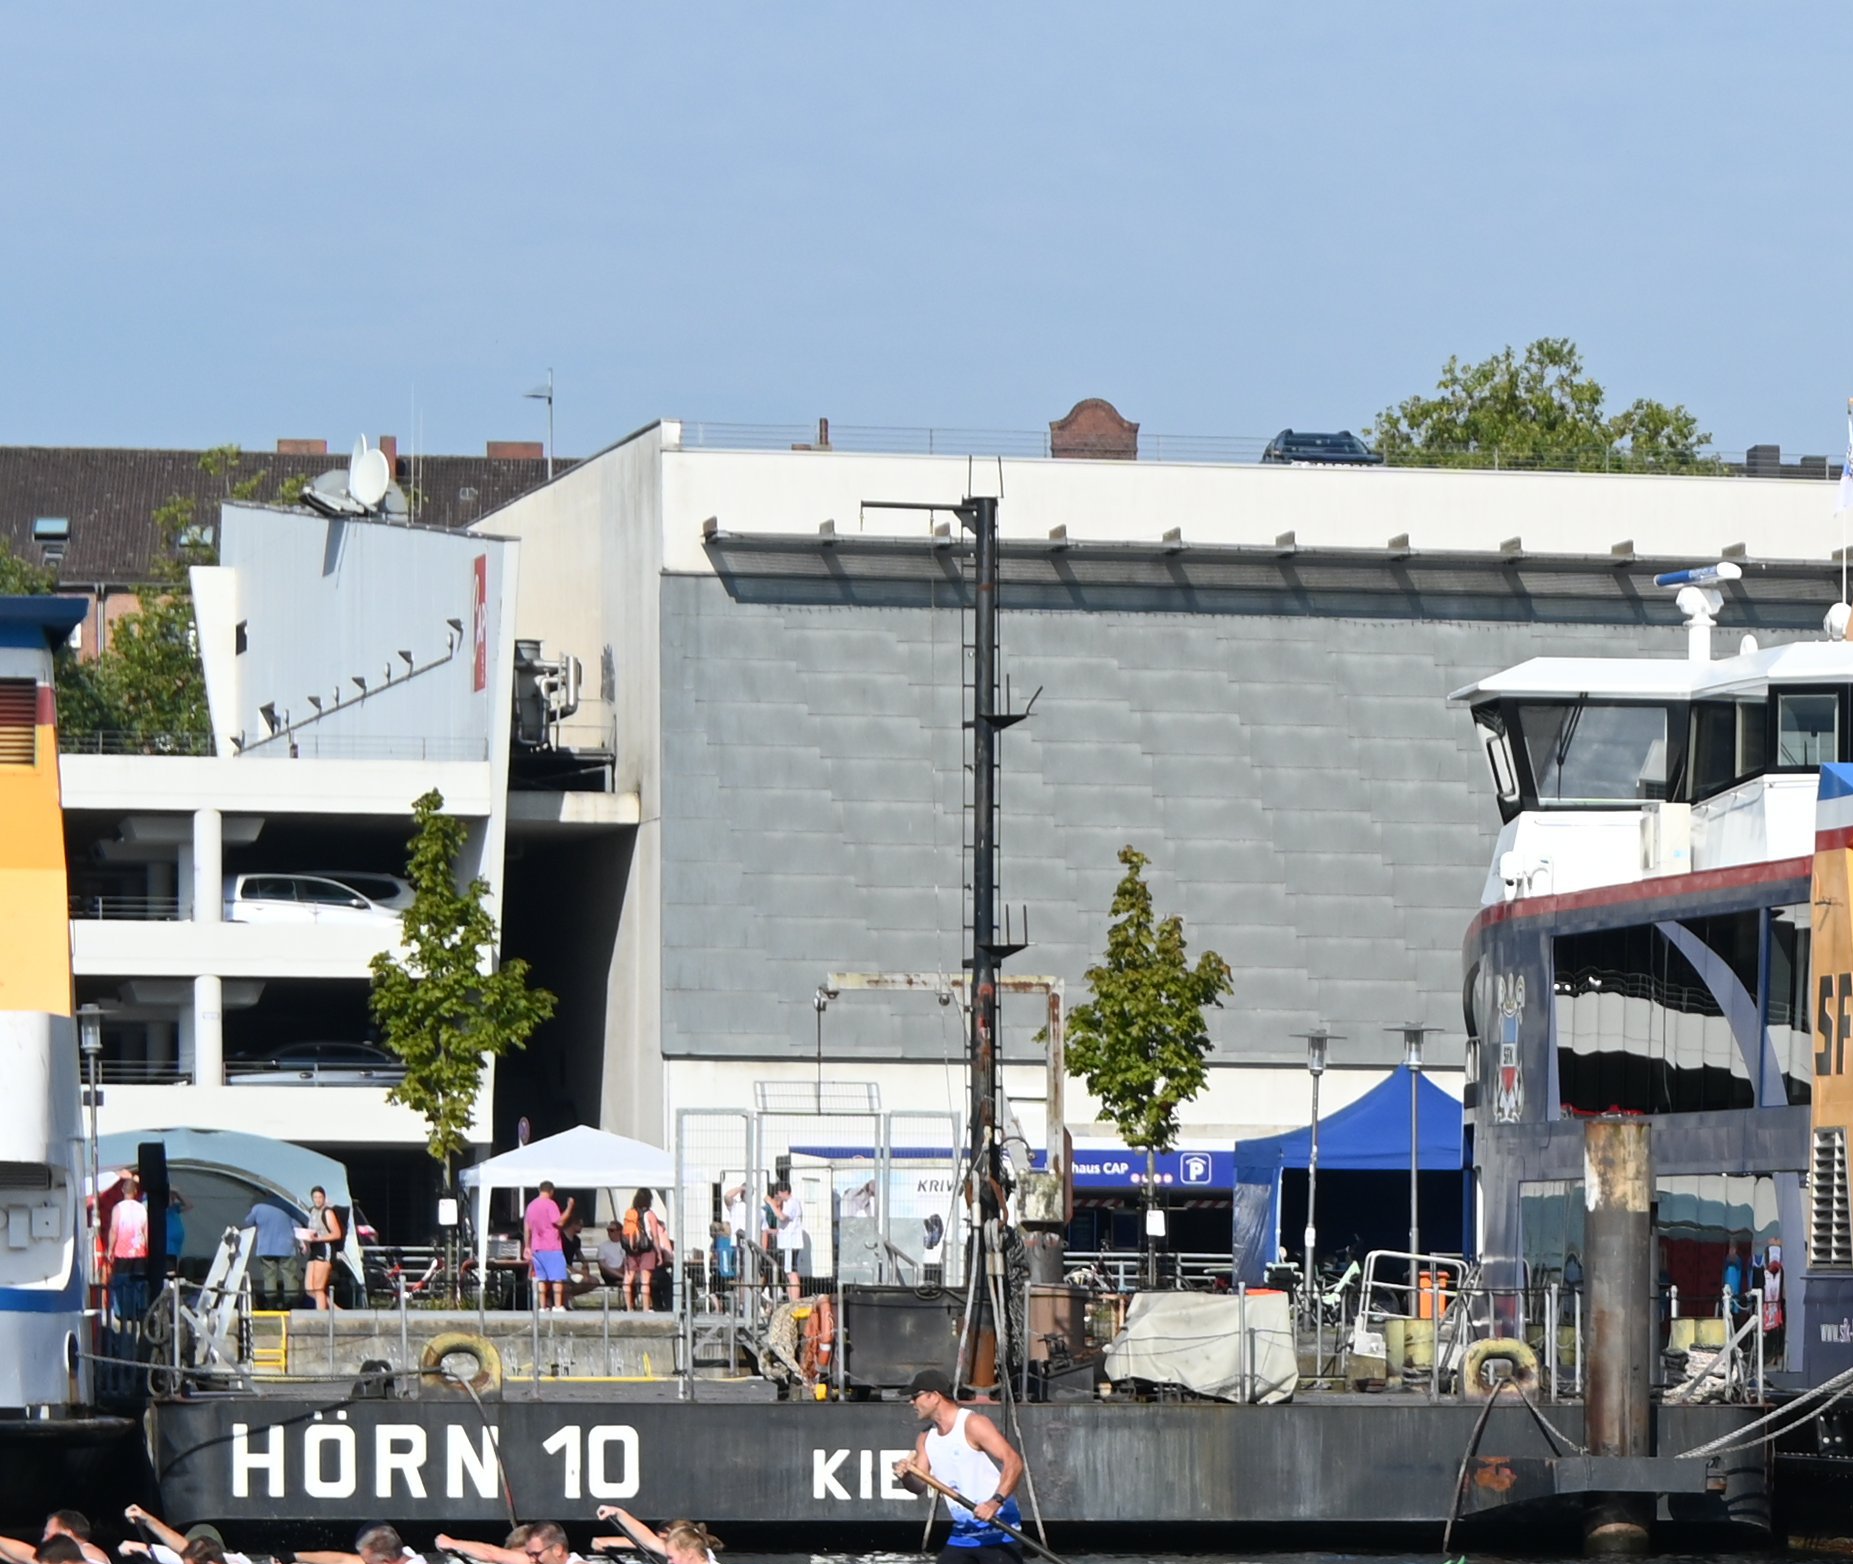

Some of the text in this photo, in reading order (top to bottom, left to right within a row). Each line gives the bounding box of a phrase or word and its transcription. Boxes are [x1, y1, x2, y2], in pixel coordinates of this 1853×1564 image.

[1102, 1161, 1130, 1175] CAP
[232, 1410, 640, 1499] HÖRN 10
[813, 1449, 940, 1500] KIE
